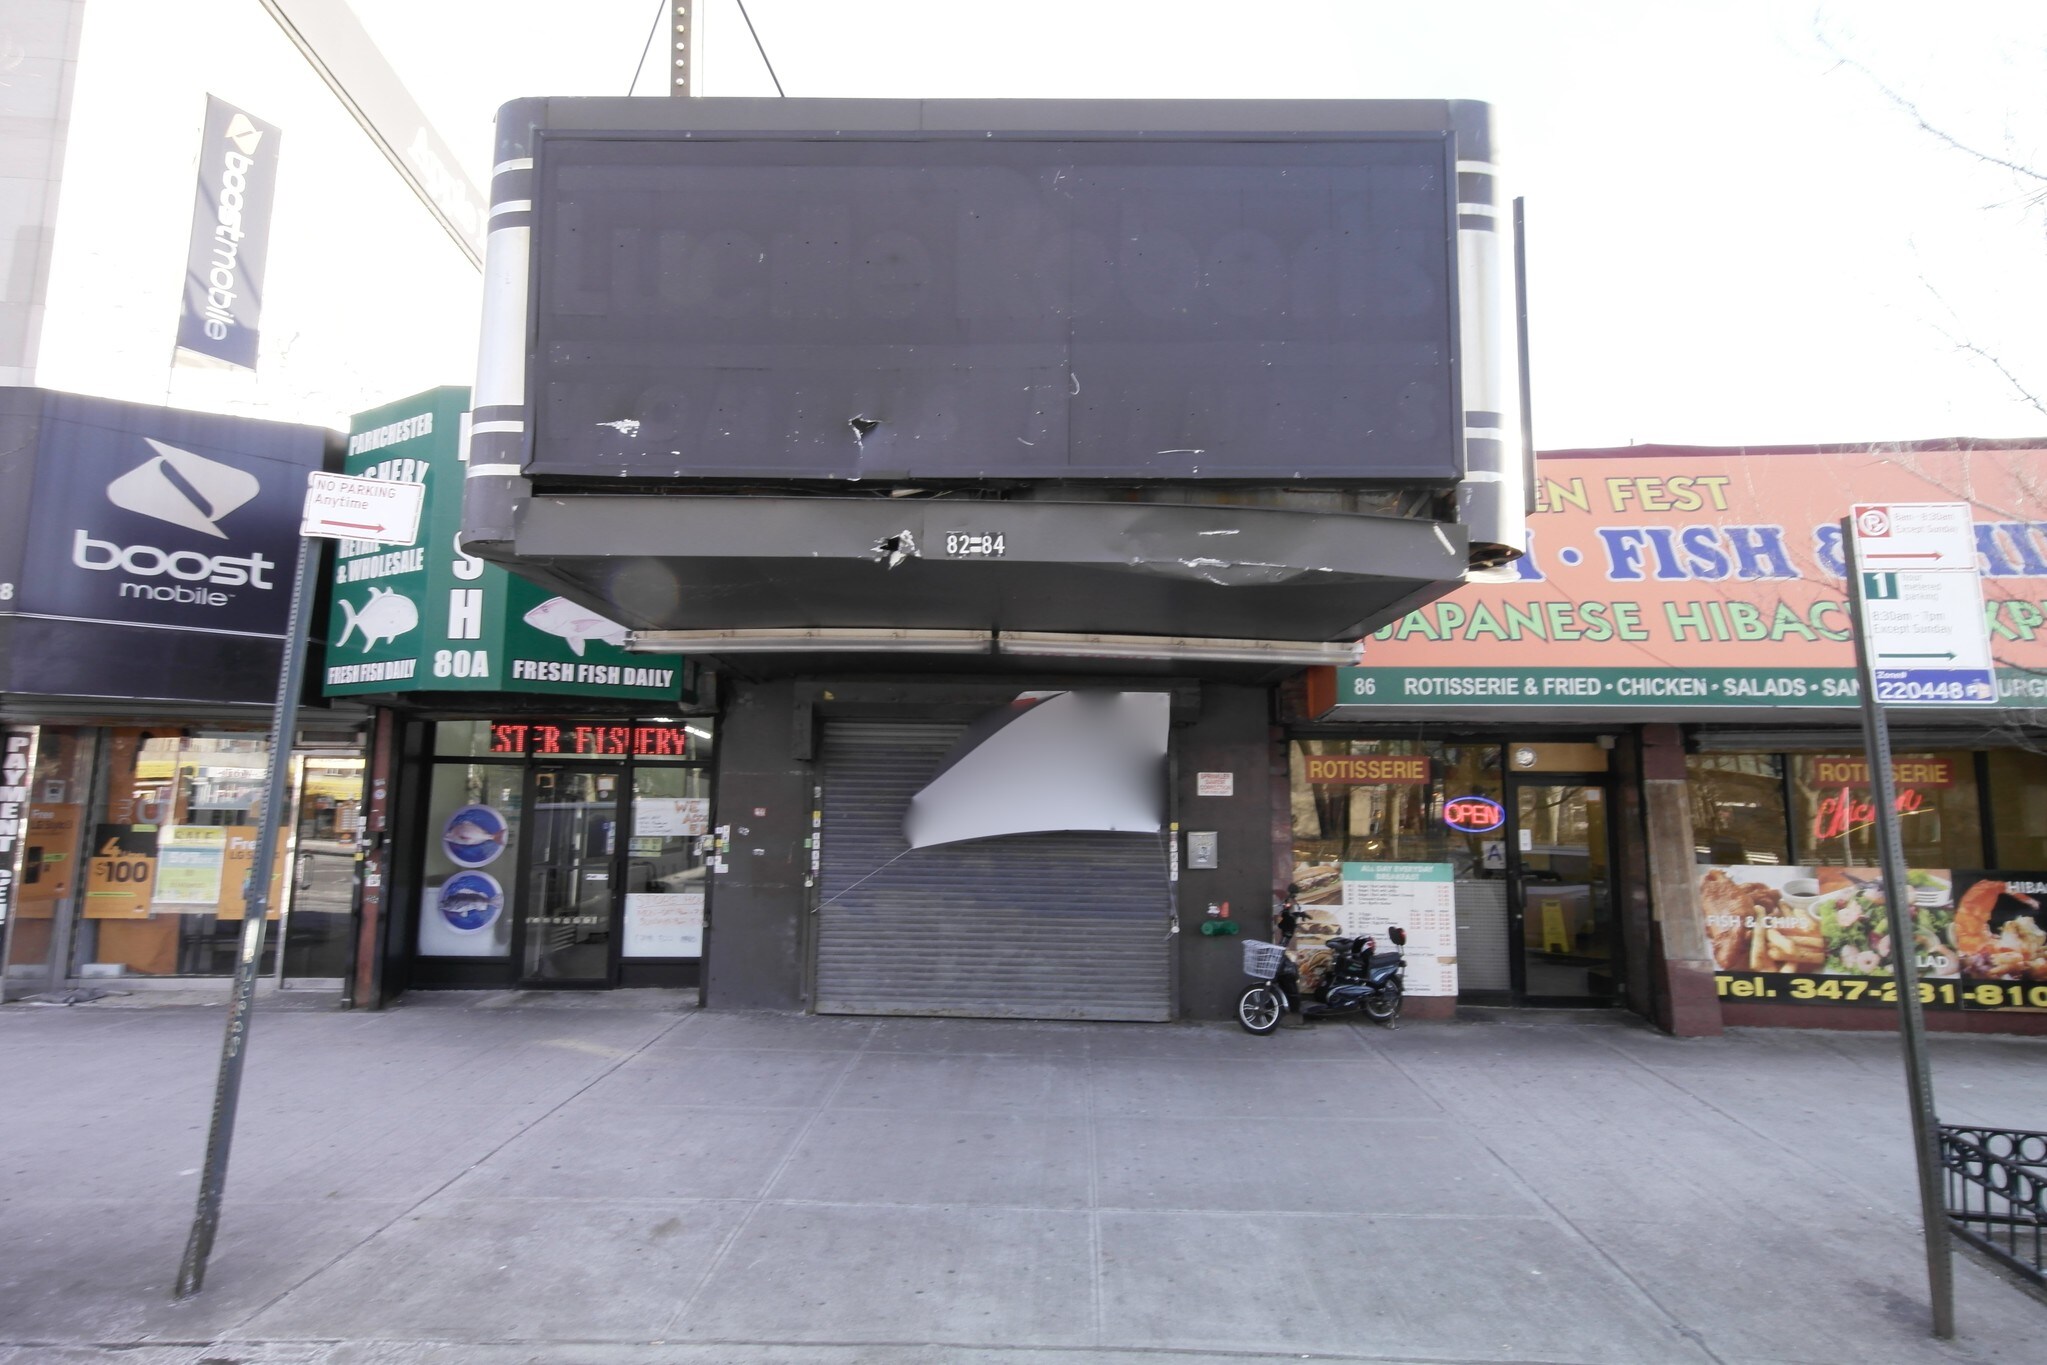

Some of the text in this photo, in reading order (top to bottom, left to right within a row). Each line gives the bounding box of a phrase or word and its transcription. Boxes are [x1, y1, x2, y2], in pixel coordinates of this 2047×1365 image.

[348, 412, 433, 456] PARKCHESTER
[316, 479, 397, 499] NO PARKING
[1605, 475, 1731, 514] FEST
[314, 493, 369, 510] Anytime
[72, 529, 275, 590] boost
[1596, 523, 1803, 583] FISH
[336, 547, 425, 584] & WHOLESALE
[119, 582, 229, 606] mobile
[1873, 611, 1910, 621] 8:30am
[1874, 624, 1953, 635] Except Sunday
[328, 658, 417, 685] FRESH FISH DAILY
[434, 650, 489, 678] 80A
[512, 659, 674, 688] FRESH FISH DAILY
[1354, 677, 1376, 696] 86
[1404, 677, 1519, 696] ROTISSERIE
[1524, 677, 1540, 696] &
[1543, 677, 1601, 696] FRIED
[1616, 678, 1708, 696] CHICKEN
[1722, 678, 1806, 697] SALADS
[1878, 681, 1964, 700] 220448
[1309, 760, 1425, 781] ROTISSERIE
[1443, 803, 1500, 825] OPEN
[1487, 844, 1502, 861] A
[96, 861, 148, 883] $100
[1361, 865, 1375, 873] ALL
[1707, 915, 1810, 930] FISH & CHIPS
[1714, 975, 1777, 998] Tel.
